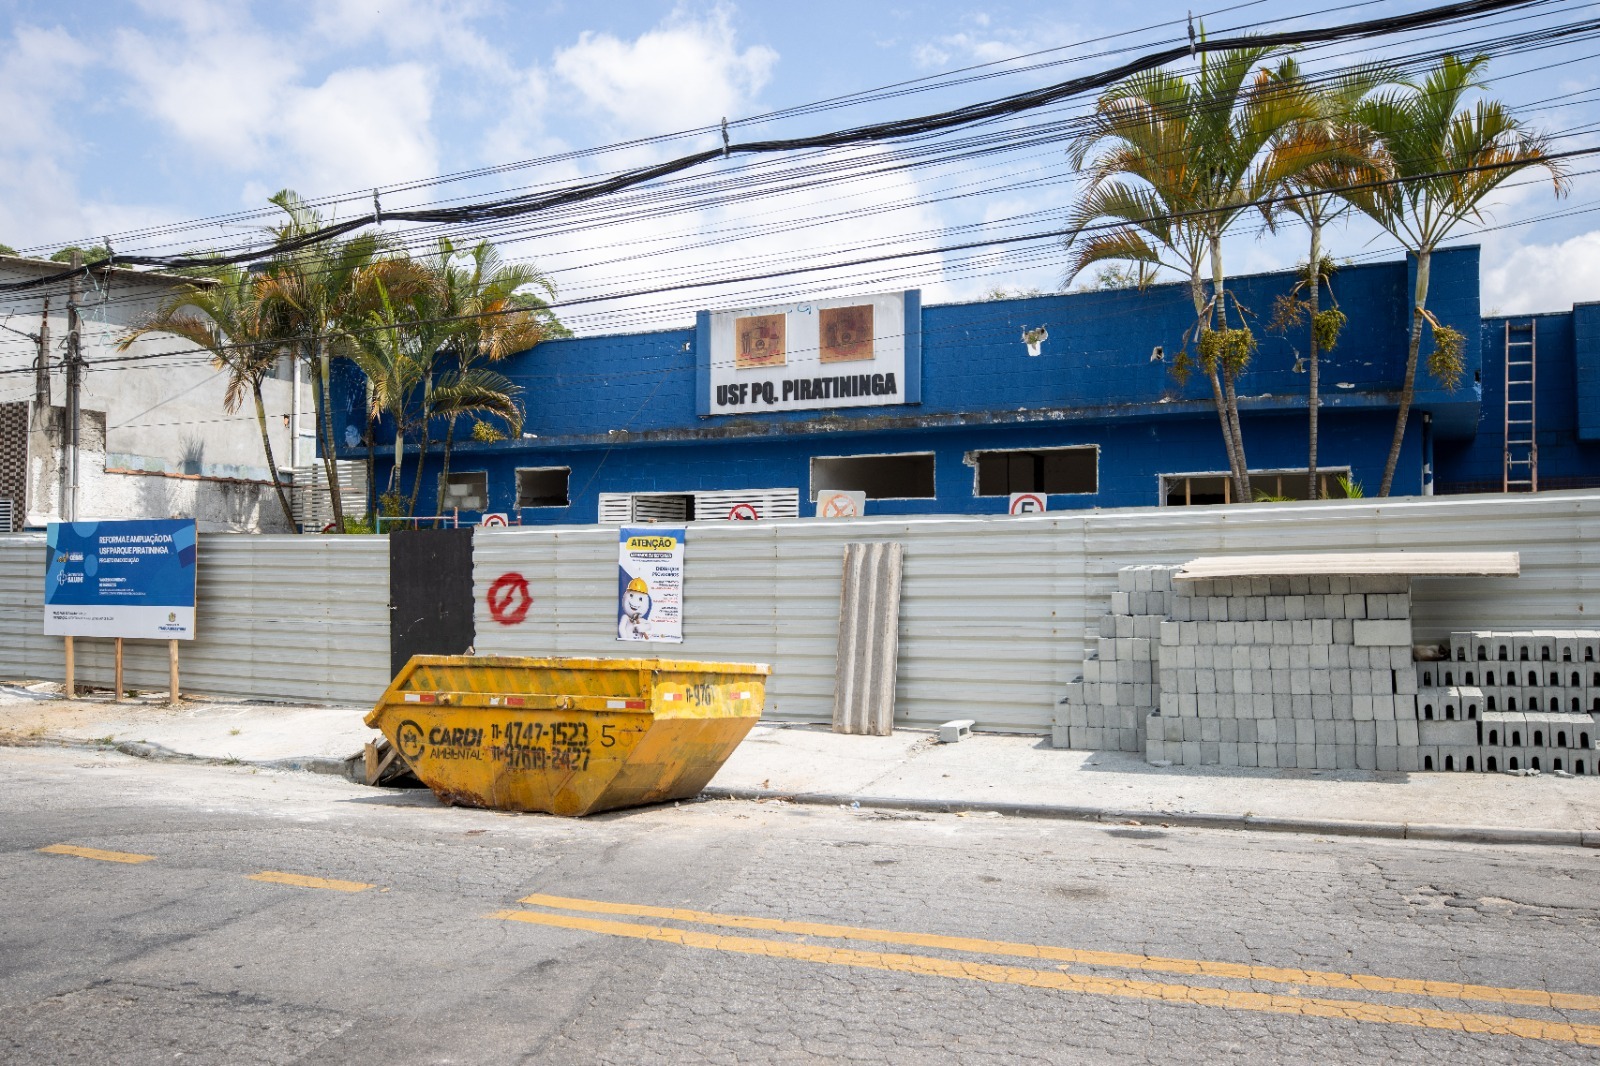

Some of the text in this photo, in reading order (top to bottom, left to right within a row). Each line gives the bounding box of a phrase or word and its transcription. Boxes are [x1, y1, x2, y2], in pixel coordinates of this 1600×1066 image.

[716, 373, 897, 406] USF PQ. PIRATININGA
[98, 536, 126, 544] REFORMA
[130, 533, 162, 545] AMPLIAÇÃO
[162, 535, 173, 543] DA
[631, 538, 672, 550] ATENÇÃO
[98, 546, 169, 555] USF PARQUE PIRATININGA
[428, 727, 484, 747] CARDI
[491, 722, 589, 746] 11-4747-1523
[600, 724, 616, 748] 5
[430, 747, 484, 760] AMBIENTAL
